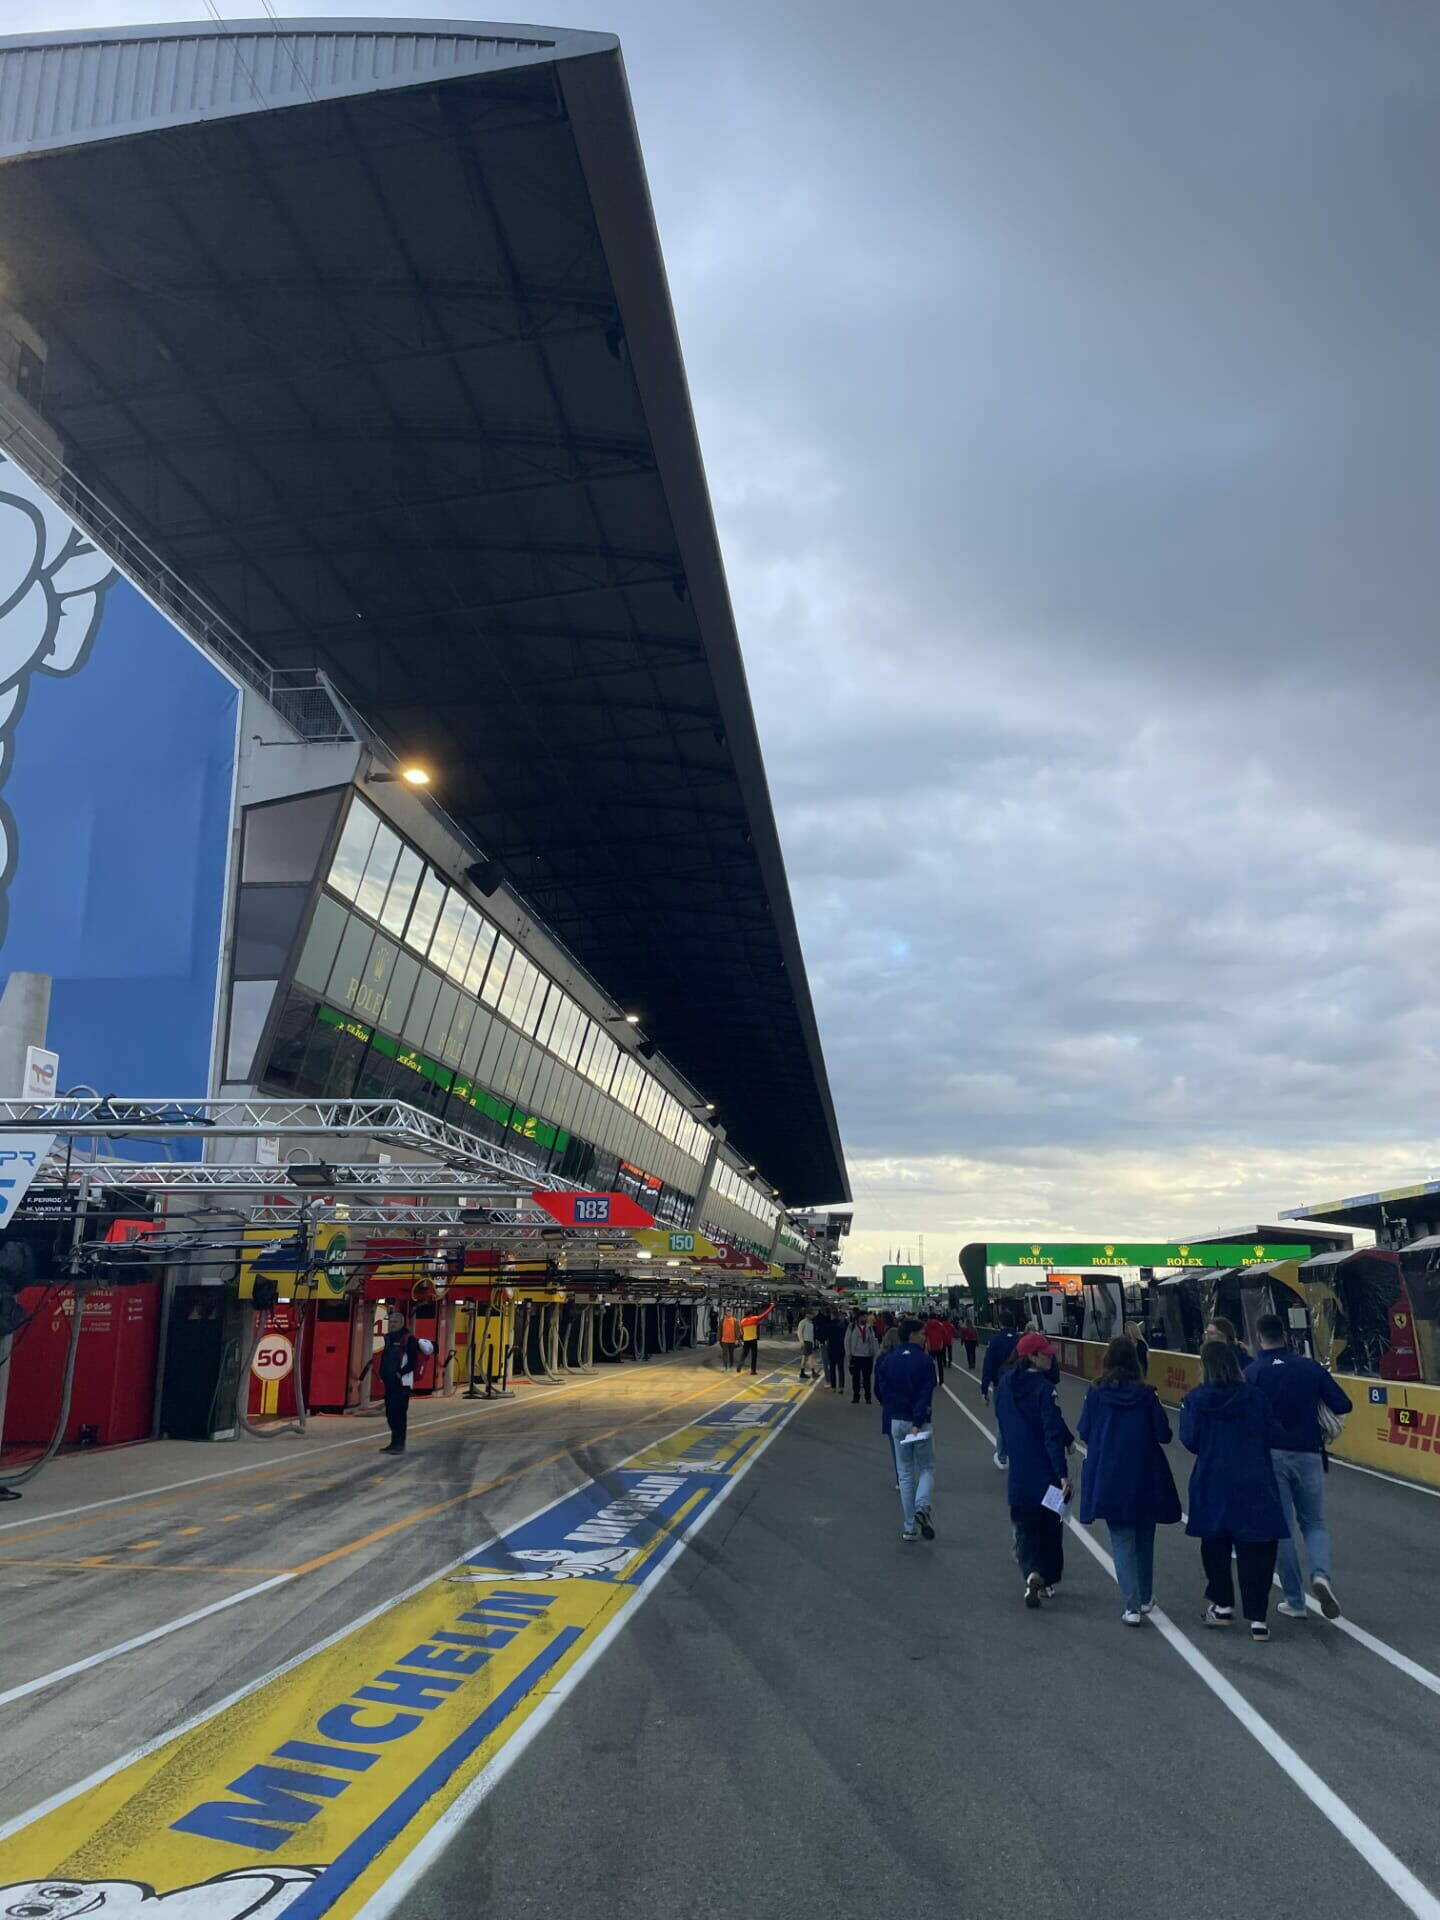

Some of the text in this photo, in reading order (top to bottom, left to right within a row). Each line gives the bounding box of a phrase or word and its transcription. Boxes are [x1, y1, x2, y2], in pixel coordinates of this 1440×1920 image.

[576, 1201, 608, 1219] 183
[670, 1234, 694, 1250] 150
[1019, 1257, 1054, 1265] ROLEX
[1092, 1257, 1128, 1266] ROLEX
[1167, 1258, 1203, 1266] ROLEX
[257, 1349, 288, 1367] 50
[1371, 1389, 1380, 1402] 8
[1399, 1410, 1410, 1424] 62
[563, 1475, 689, 1545] MICHELIN
[170, 1590, 559, 1852] MICHELIN
